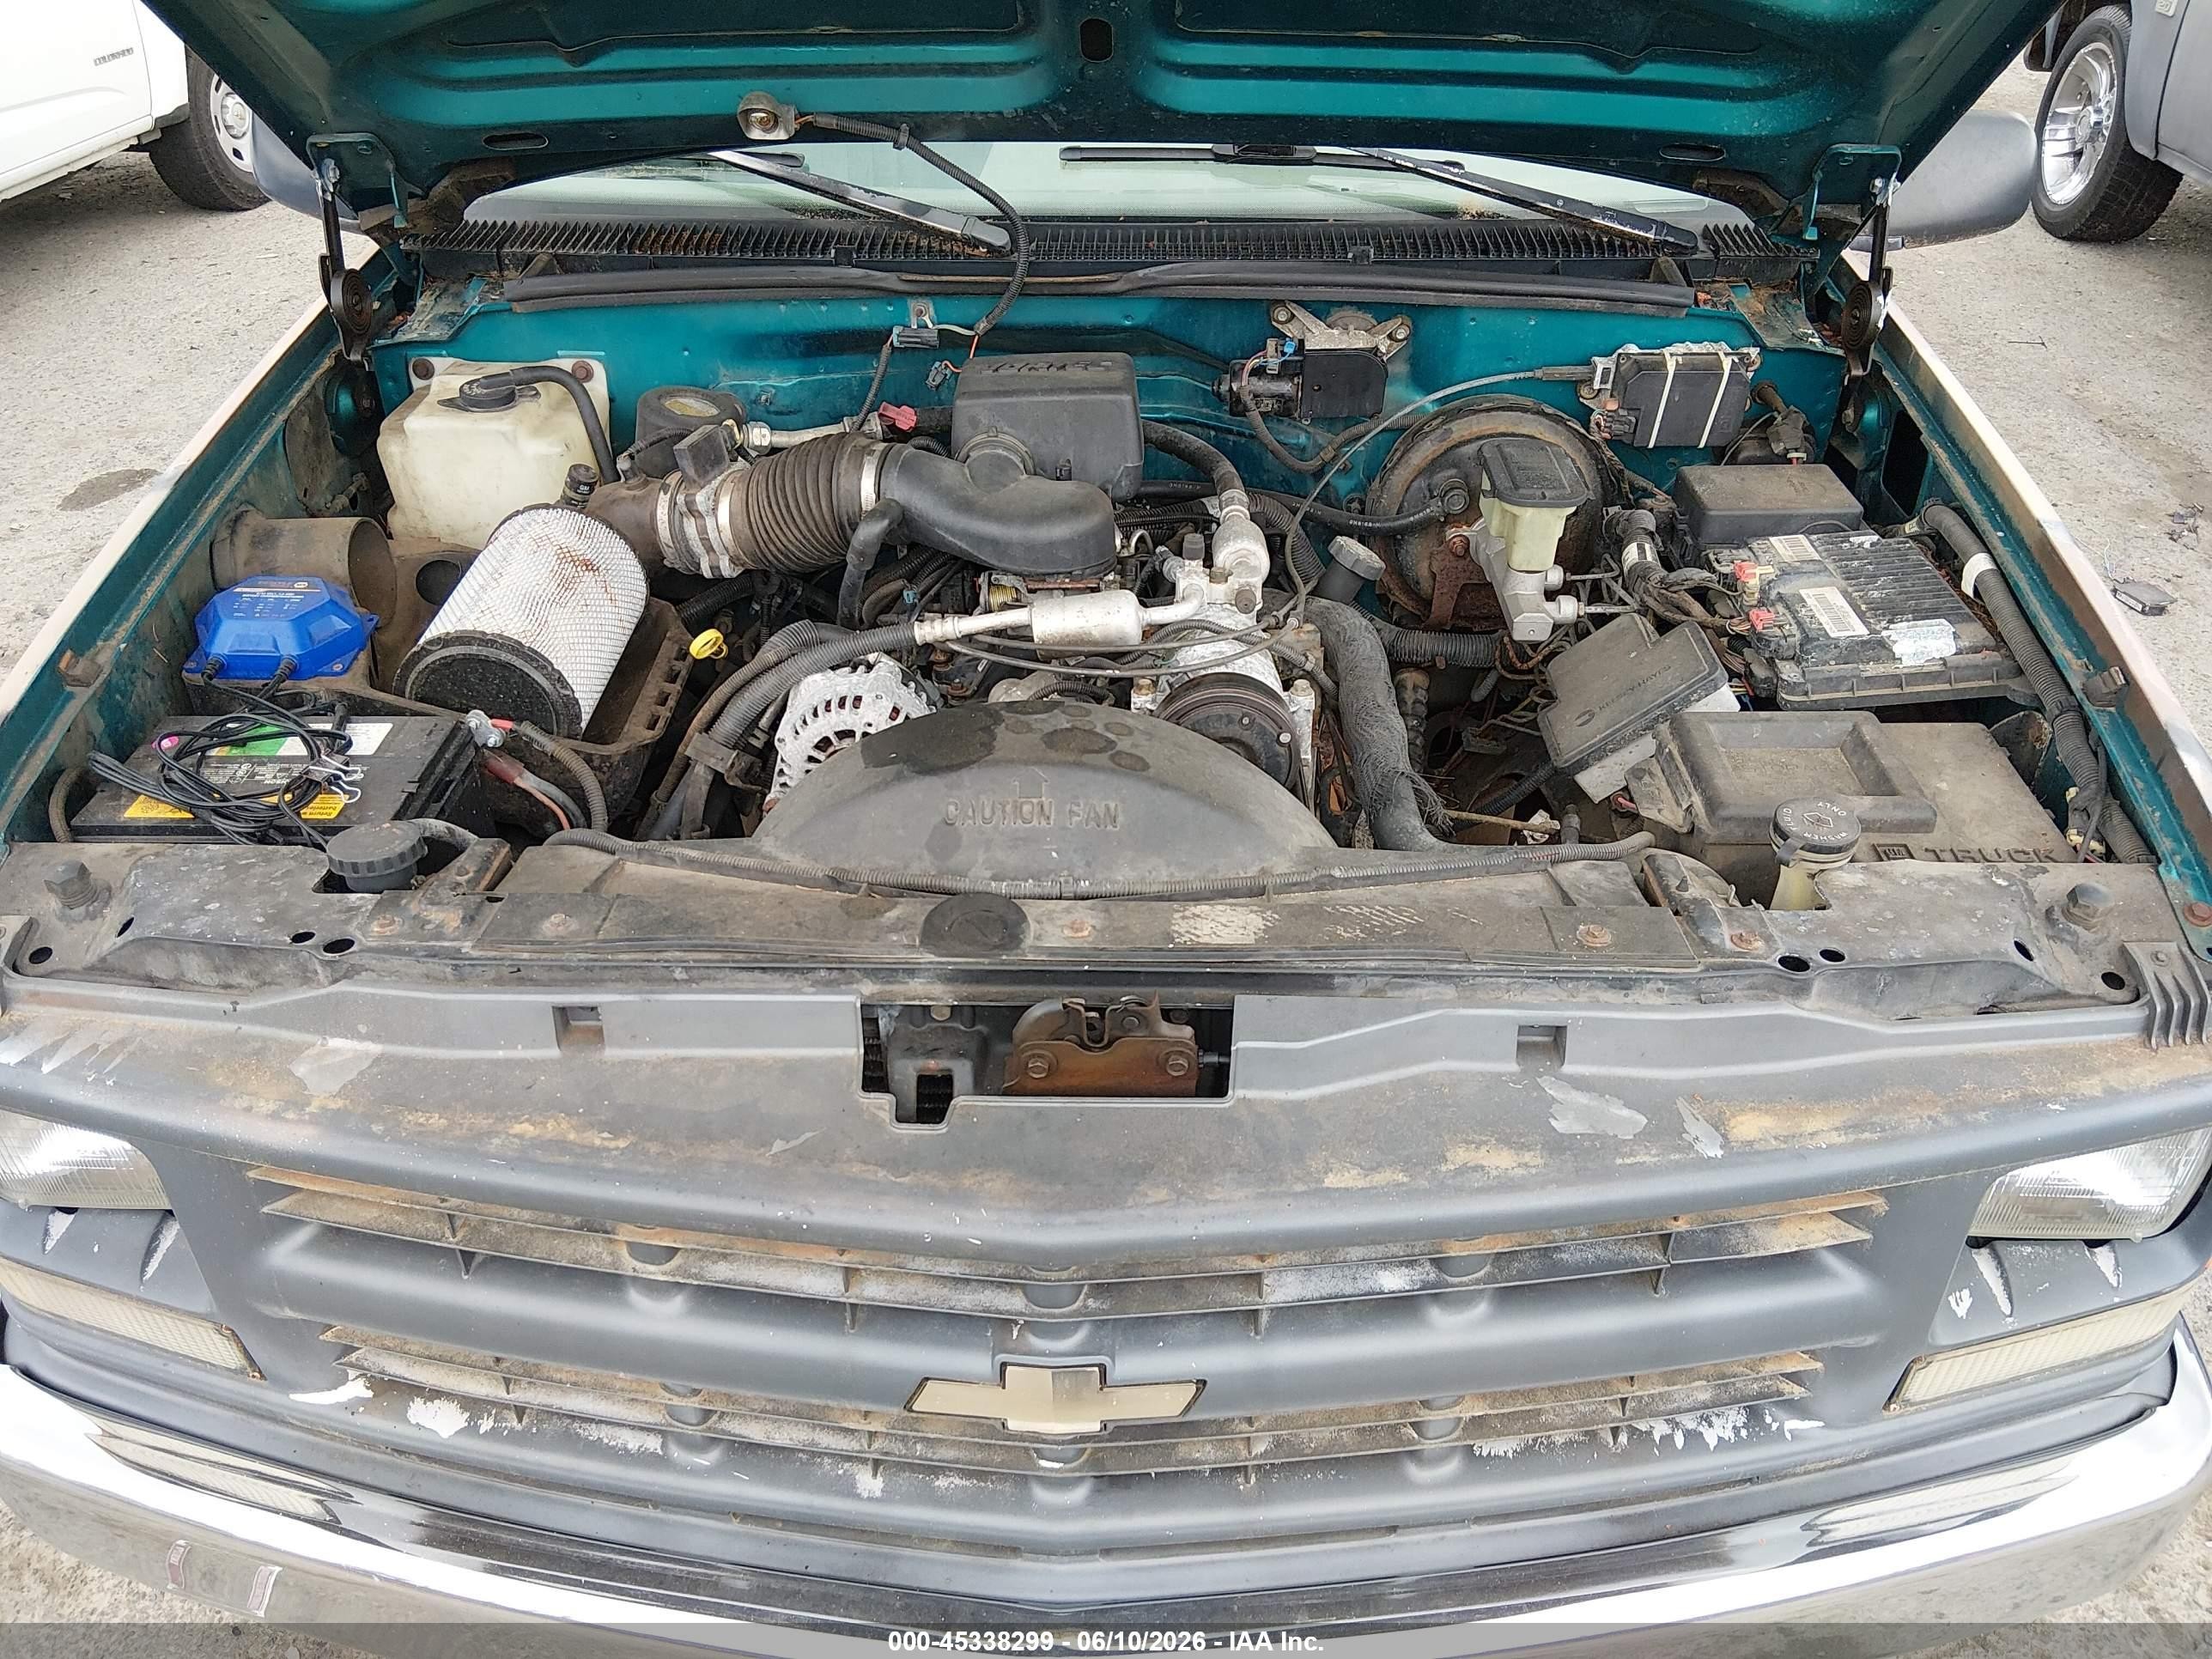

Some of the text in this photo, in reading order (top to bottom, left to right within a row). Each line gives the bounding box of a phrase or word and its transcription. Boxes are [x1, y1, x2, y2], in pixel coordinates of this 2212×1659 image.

[945, 799, 1120, 830] CAUTION FAN
[1783, 801, 1849, 841] WASHER FLUID ONLY
[1923, 847, 2055, 862] TRUCK
